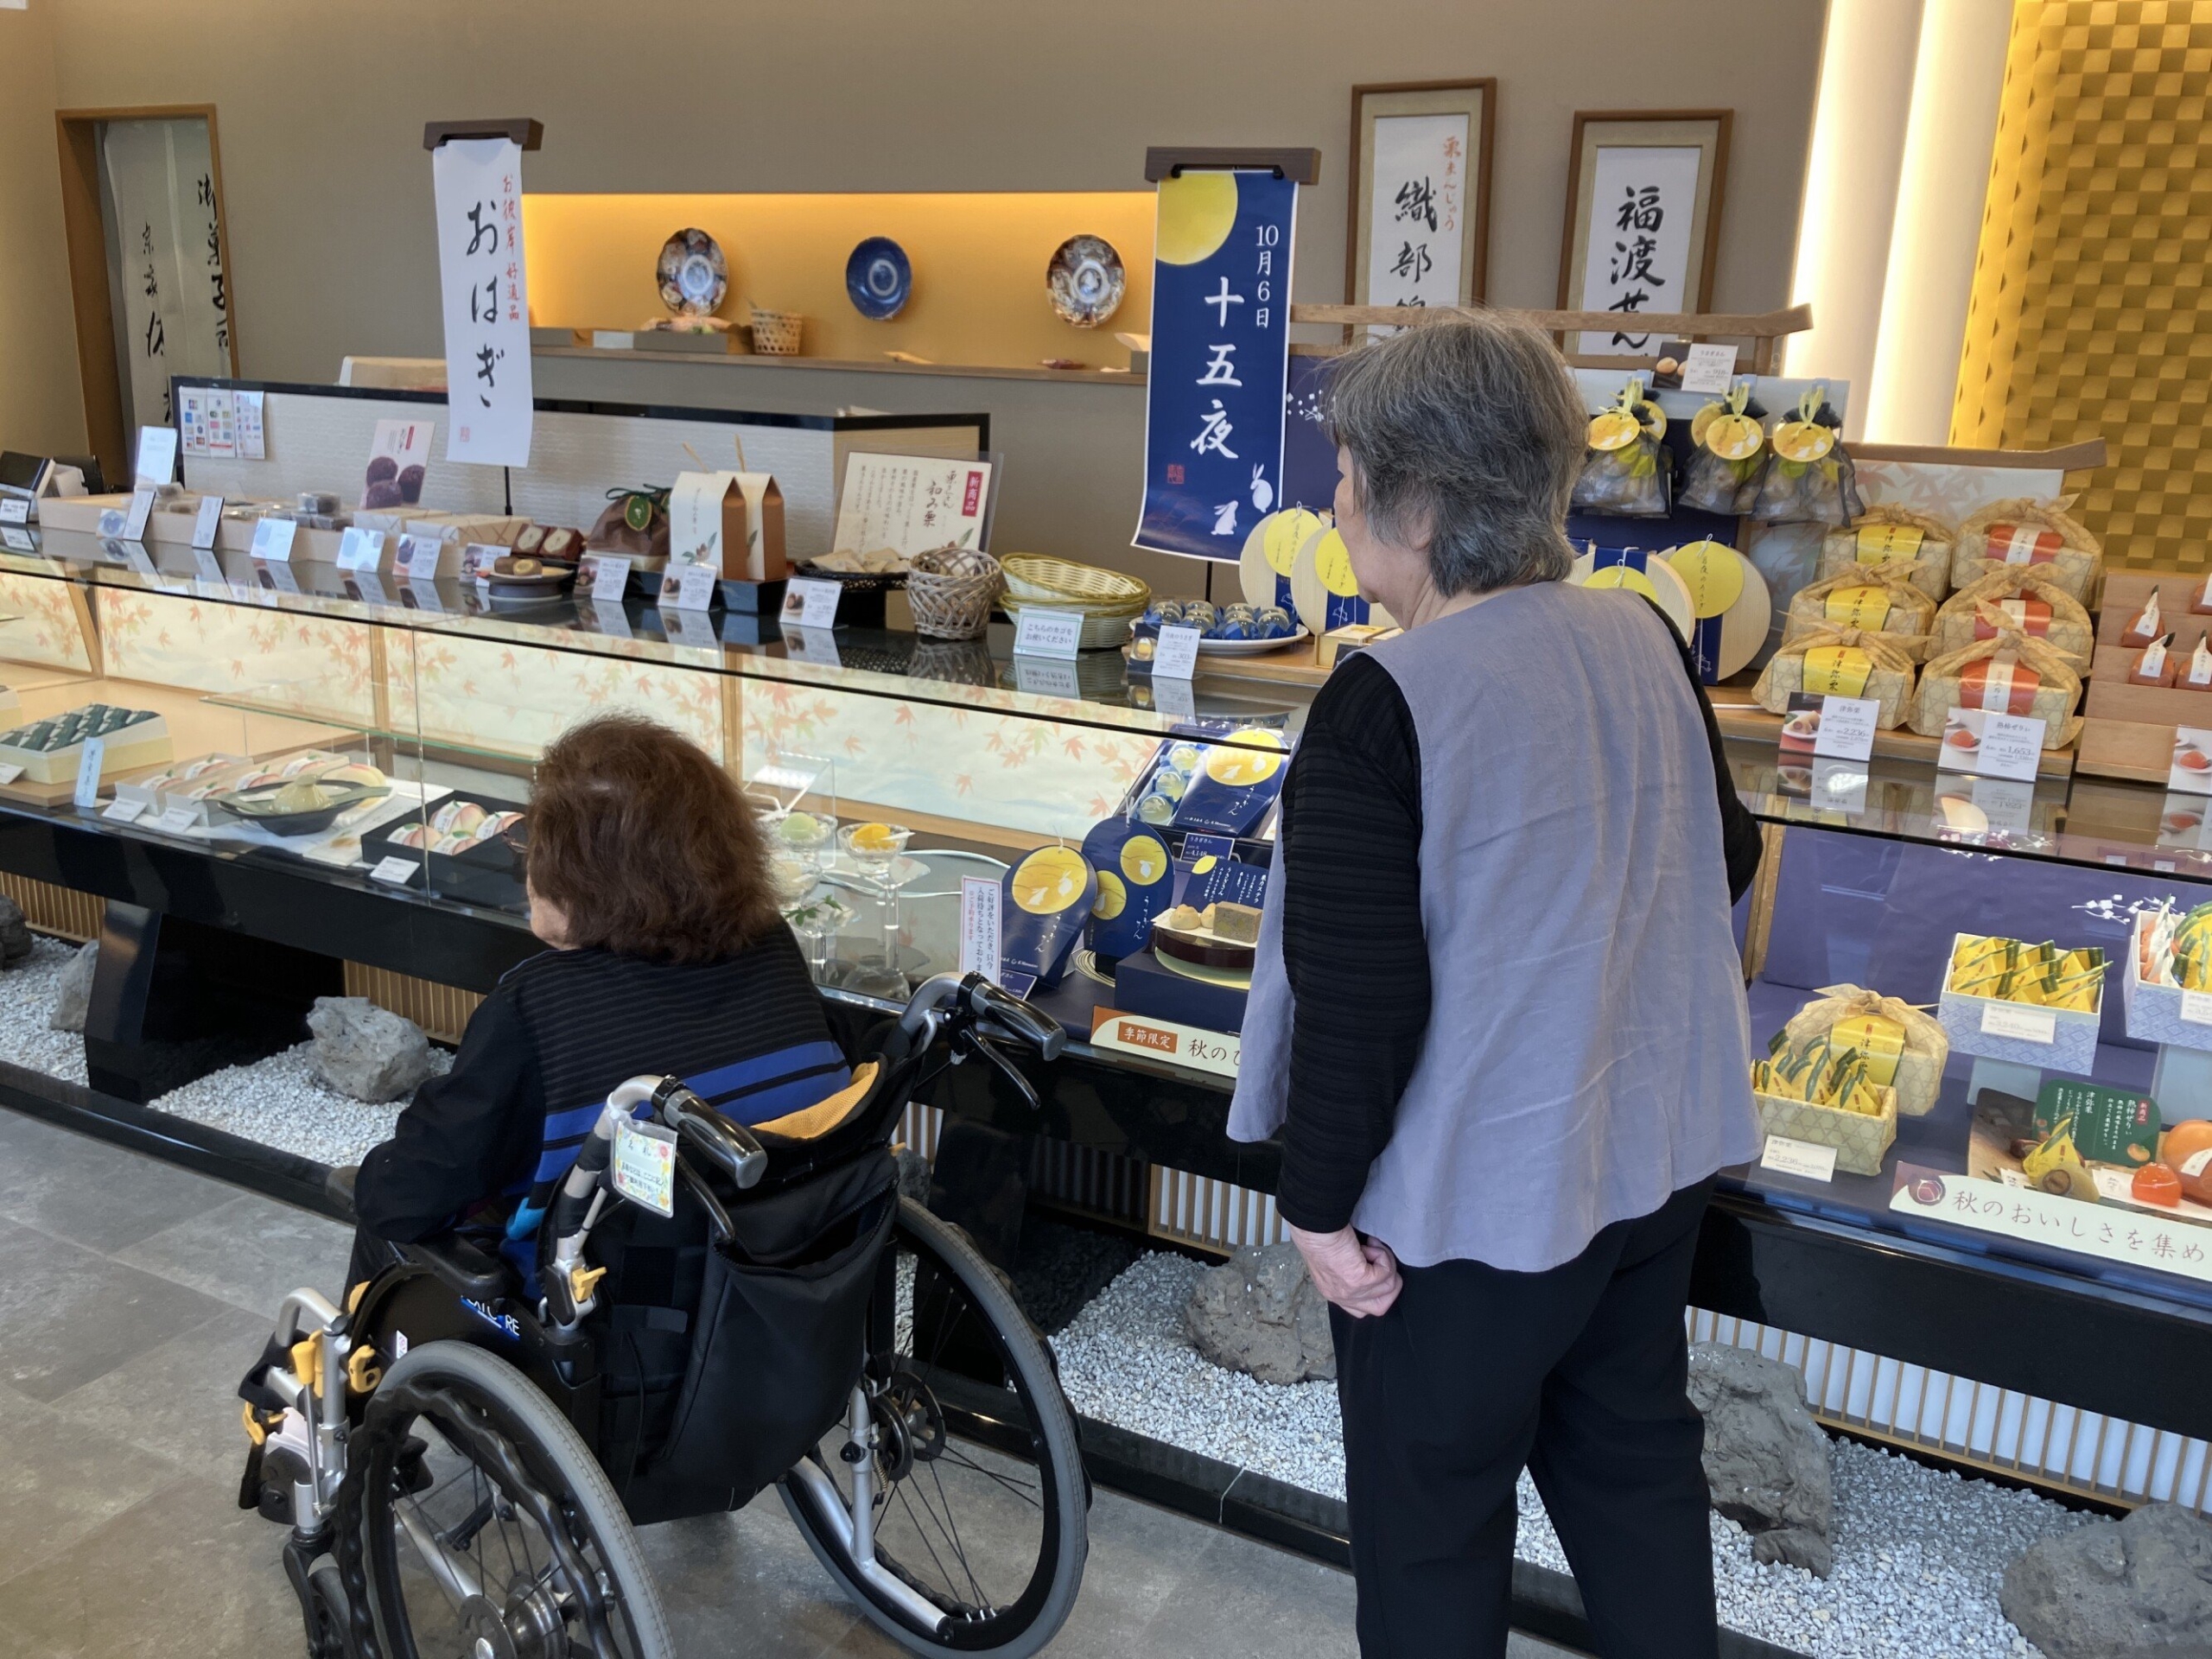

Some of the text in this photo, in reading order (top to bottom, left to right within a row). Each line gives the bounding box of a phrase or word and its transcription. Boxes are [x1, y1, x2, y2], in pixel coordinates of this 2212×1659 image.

[1443, 137, 1462, 232] 栗まんじゅう
[1255, 225, 1279, 329] 10月6日
[1609, 186, 1666, 355] 福渡せん
[467, 200, 504, 408] おはぎ
[1191, 276, 1245, 460] 十五夜
[923, 480, 943, 528] 和み栗
[965, 476, 980, 512] 新商品
[1026, 633, 1071, 644] お使いください
[1027, 624, 1072, 635] こちらのカゴを
[1124, 1026, 1171, 1049] 季節限定
[2085, 1091, 2095, 1114] 津弥栗
[1953, 1190, 2205, 1263] 秋のおいしさを集め
